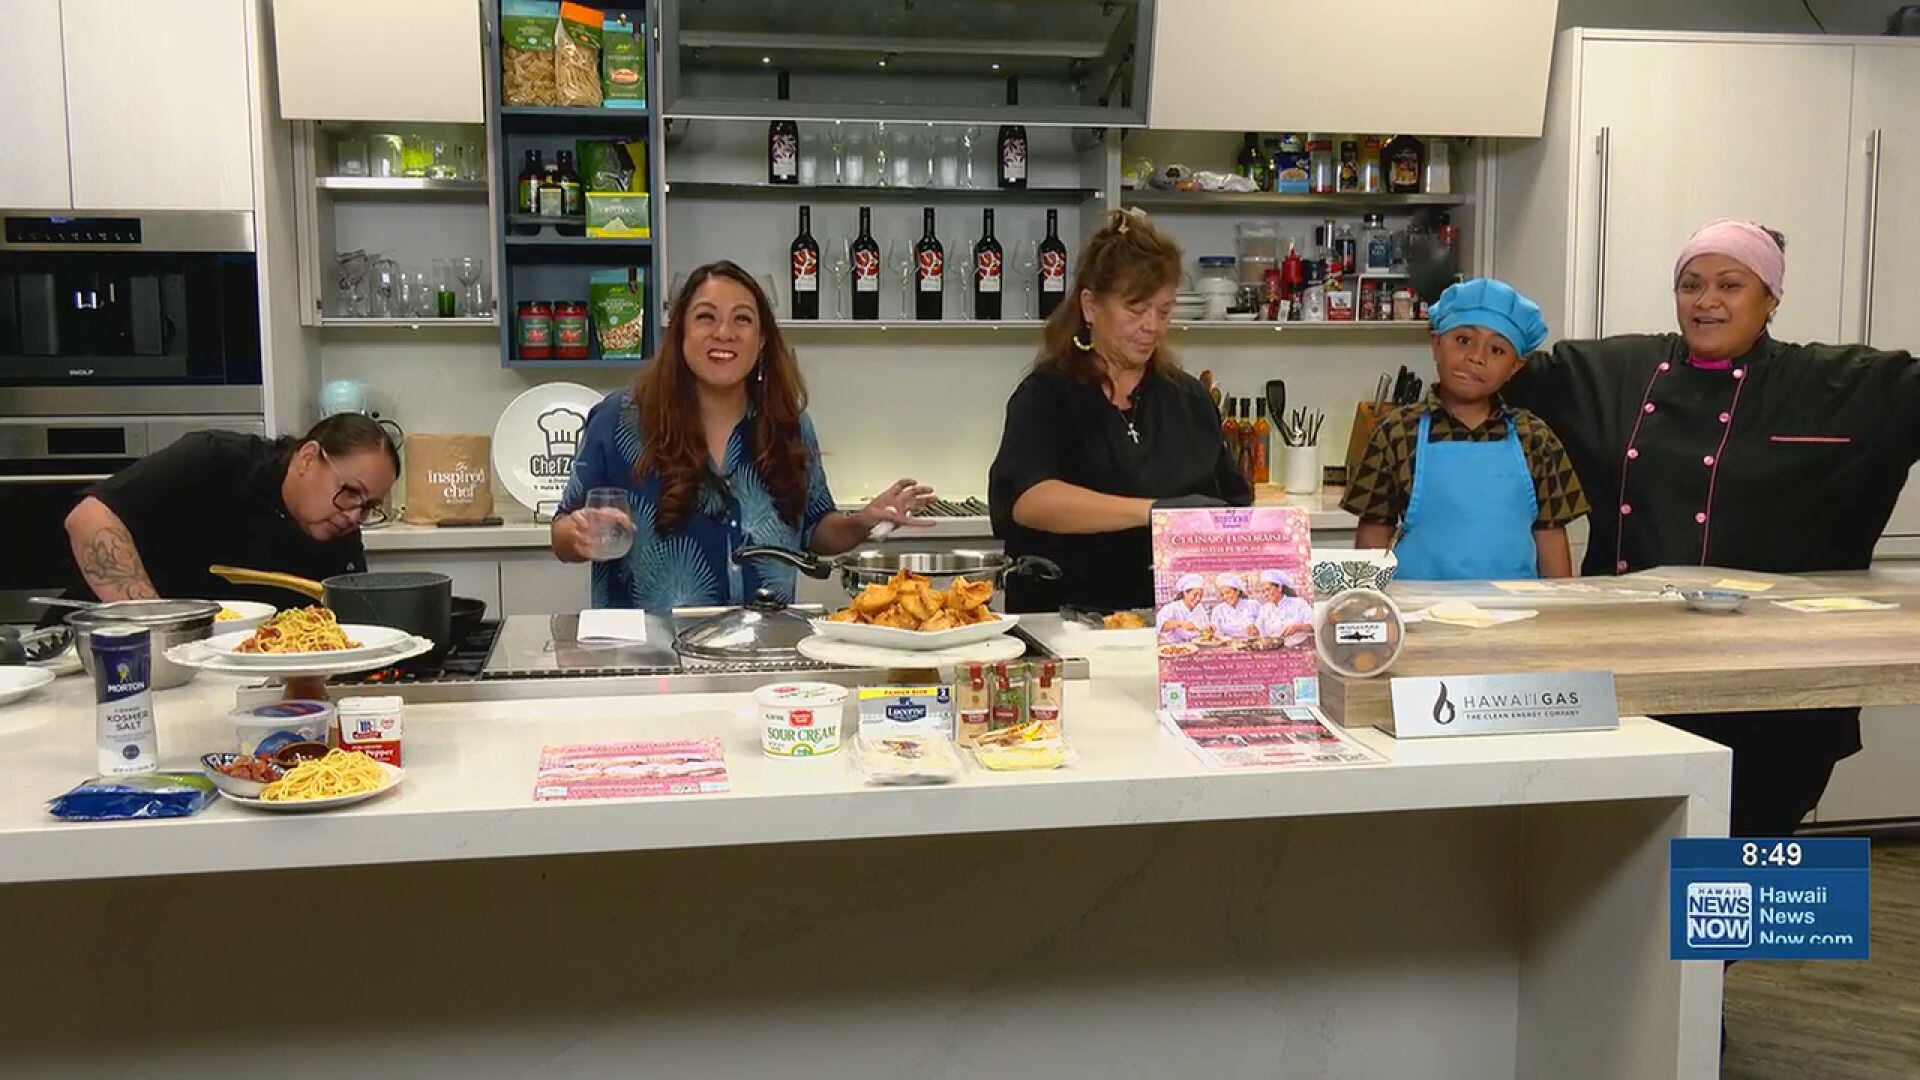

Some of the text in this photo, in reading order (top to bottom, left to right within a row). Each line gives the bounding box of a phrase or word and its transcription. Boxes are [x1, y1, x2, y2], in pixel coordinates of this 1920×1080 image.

[530, 455, 571, 477] ChefZ
[428, 468, 485, 486] inspired
[443, 485, 475, 499] chef
[1170, 532, 1223, 545] CULINARY
[107, 681, 145, 693] MORTON
[1541, 692, 1579, 705] GAS
[107, 710, 149, 722] KOSHER
[887, 707, 925, 716] Lucerne
[116, 720, 142, 731] SALT
[767, 725, 837, 743] SOUR CREAM
